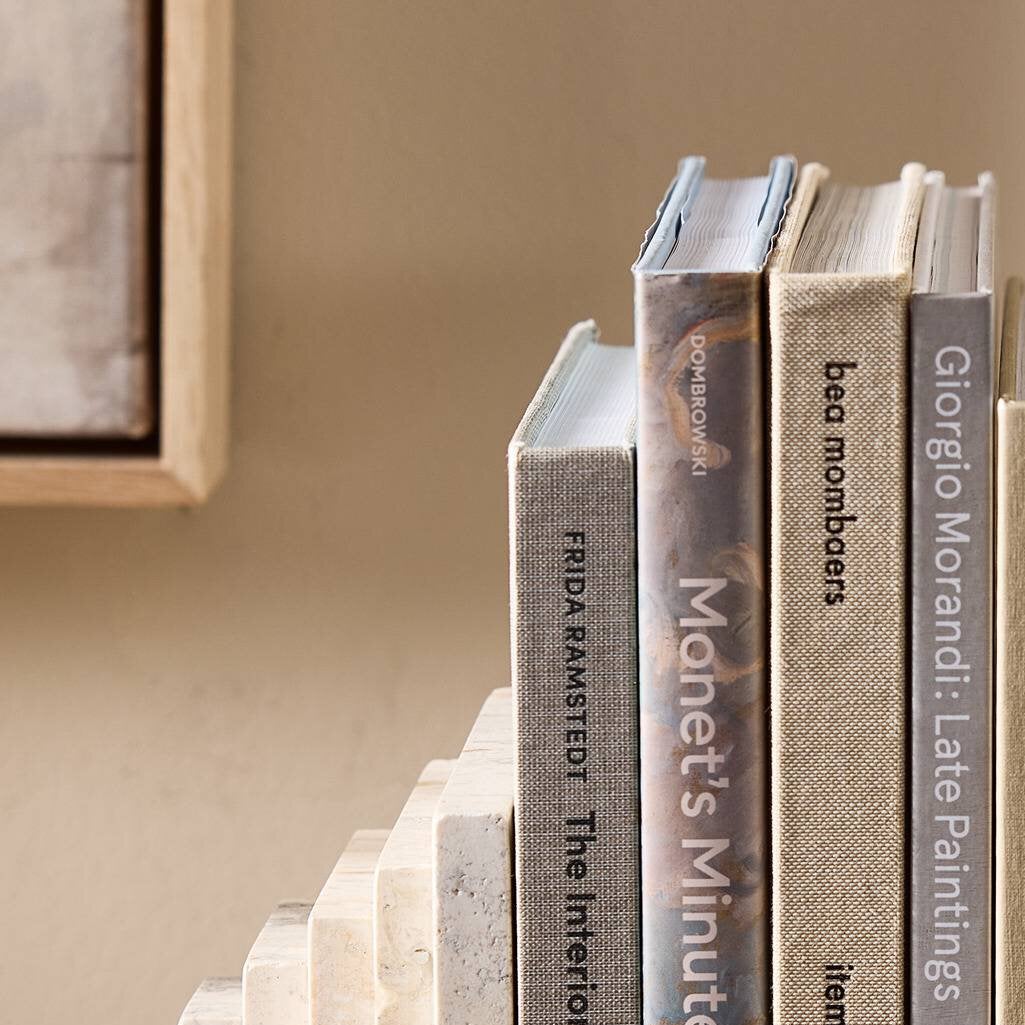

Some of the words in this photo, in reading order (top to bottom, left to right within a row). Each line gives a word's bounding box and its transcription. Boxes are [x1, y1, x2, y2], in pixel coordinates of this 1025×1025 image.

[690, 334, 708, 476] DOMBROWSKI
[823, 362, 857, 424] bea
[925, 345, 971, 500] Giorgio
[564, 531, 585, 617] FRIDA
[823, 437, 857, 606] mombaers
[566, 627, 587, 783] RAMSTEDT
[679, 578, 730, 817] Monet's
[934, 714, 970, 803] Late
[566, 811, 595, 880] The
[924, 815, 970, 1001] Paintings
